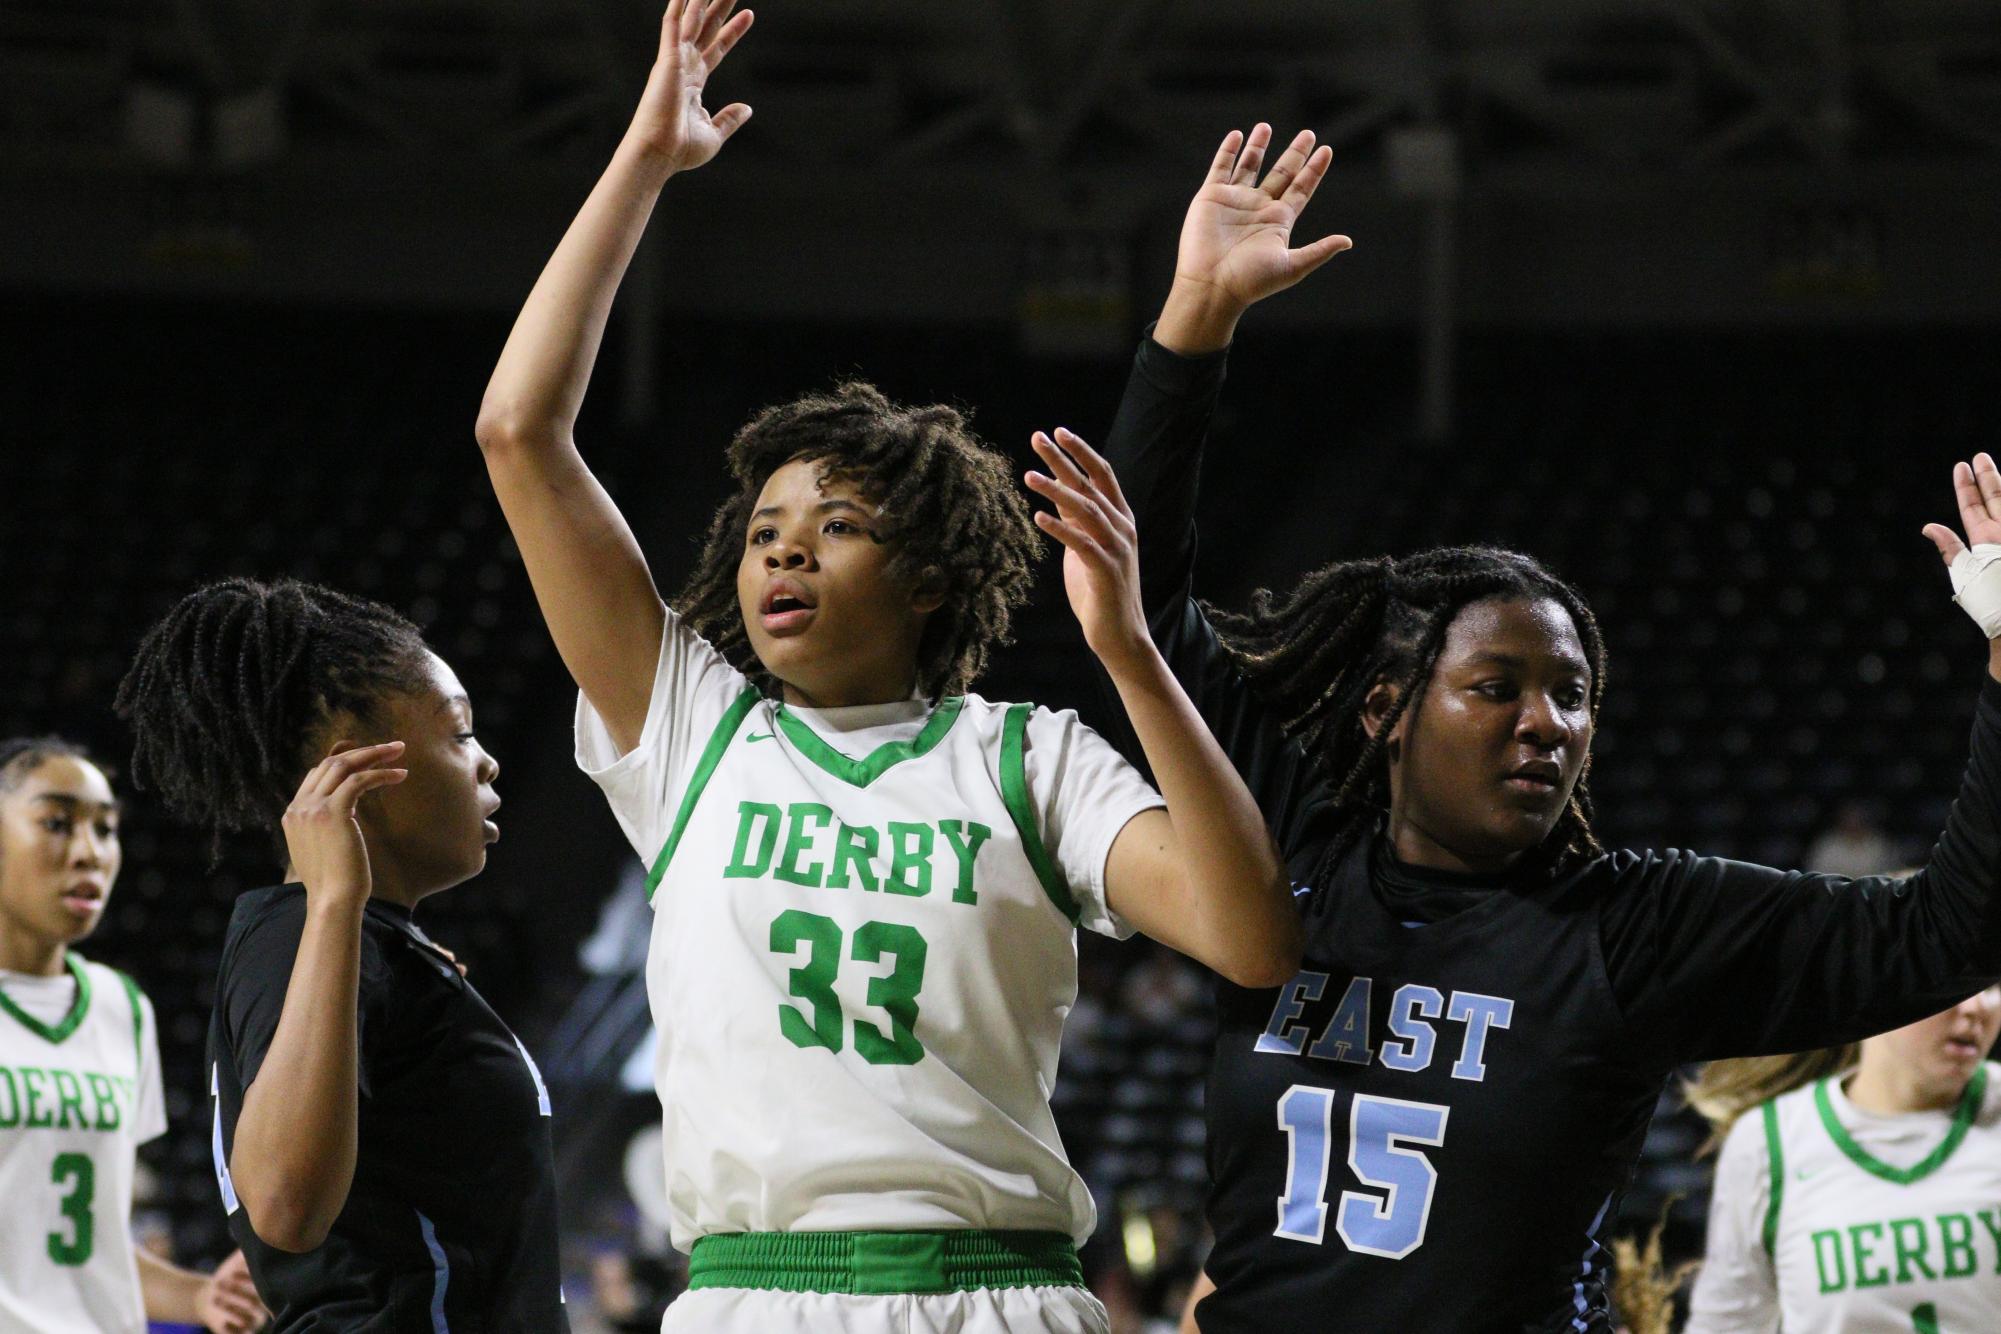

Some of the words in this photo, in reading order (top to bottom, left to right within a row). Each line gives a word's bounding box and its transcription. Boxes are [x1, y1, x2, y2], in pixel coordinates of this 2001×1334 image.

[723, 801, 991, 905] DERBY
[769, 908, 928, 1066] 33
[1253, 969, 1515, 1083] EAST
[47, 1152, 95, 1267] 3
[1273, 1084, 1451, 1260] 15
